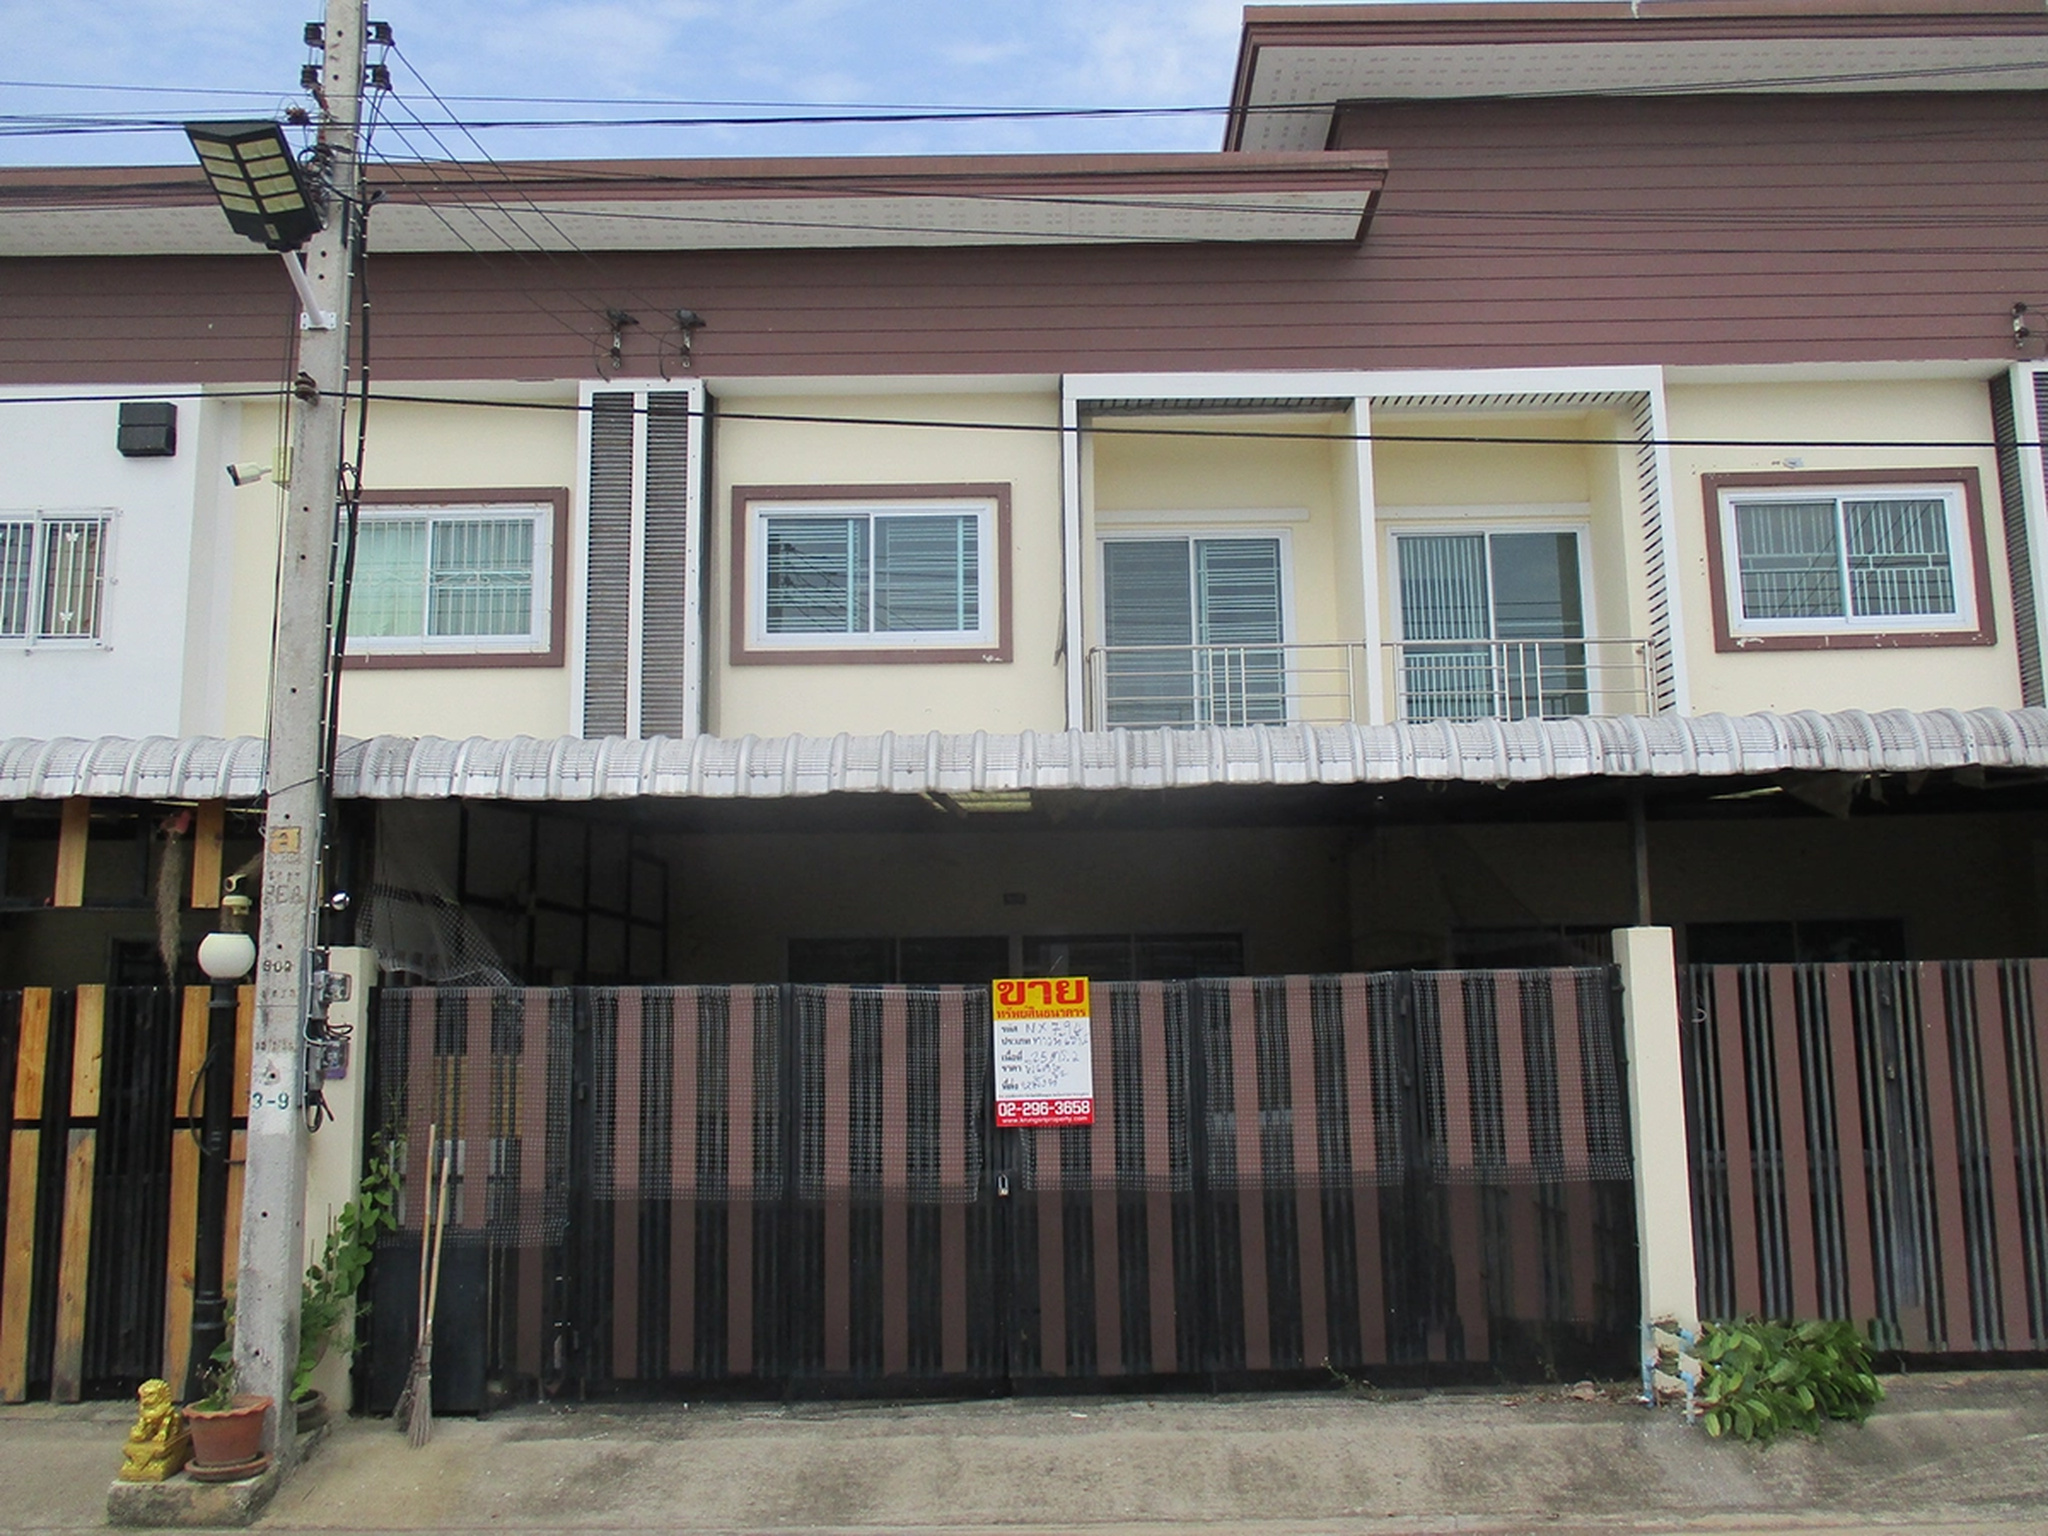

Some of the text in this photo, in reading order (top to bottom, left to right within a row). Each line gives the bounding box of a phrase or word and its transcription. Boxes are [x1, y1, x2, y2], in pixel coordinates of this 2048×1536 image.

[996, 979, 1085, 1006] ขาย
[252, 1092, 289, 1110] 3-9
[998, 1100, 1091, 1117] 02-296-3658
